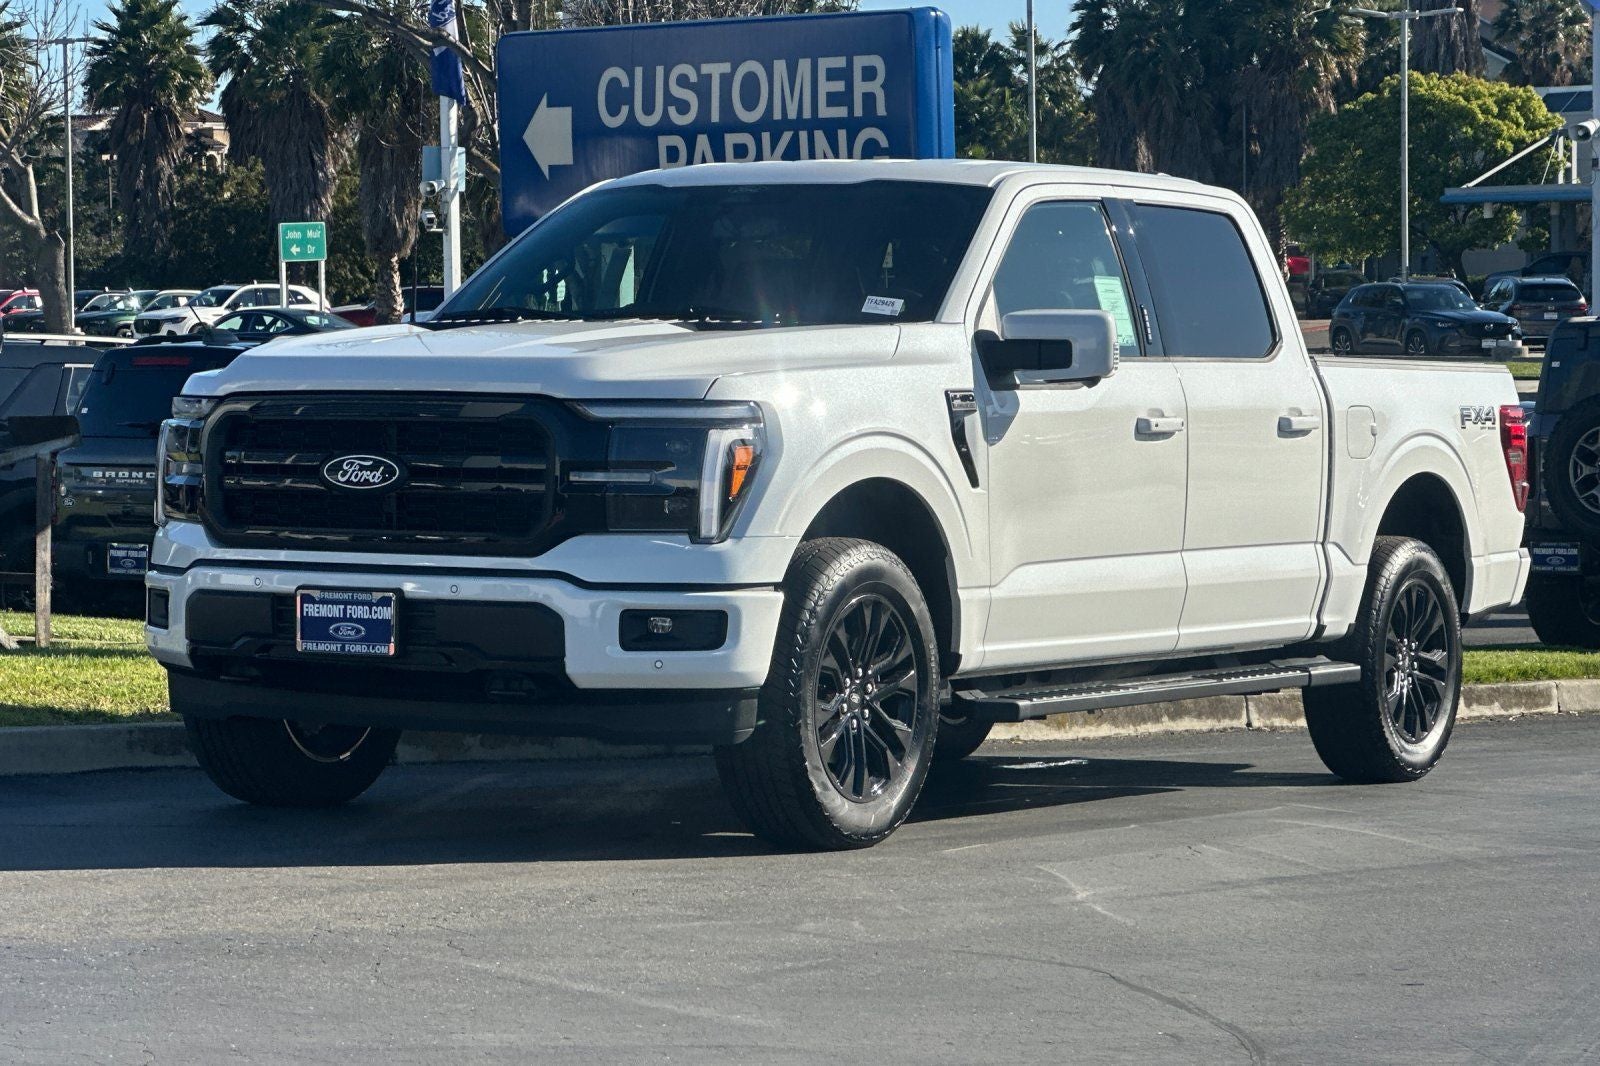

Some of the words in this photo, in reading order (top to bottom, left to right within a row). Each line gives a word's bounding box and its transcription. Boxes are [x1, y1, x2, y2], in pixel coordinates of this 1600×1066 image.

[597, 54, 888, 128] CUSTOMER
[285, 230, 302, 239] John
[306, 229, 321, 238] Muir
[307, 244, 315, 253] Dr
[1460, 405, 1496, 429] FX4
[338, 459, 385, 483] Ford
[320, 592, 353, 601] FREMONT
[353, 593, 372, 601] FORD
[303, 603, 345, 618] FREMONT
[346, 605, 392, 620] FORD.COM
[302, 642, 342, 652] FREMONT
